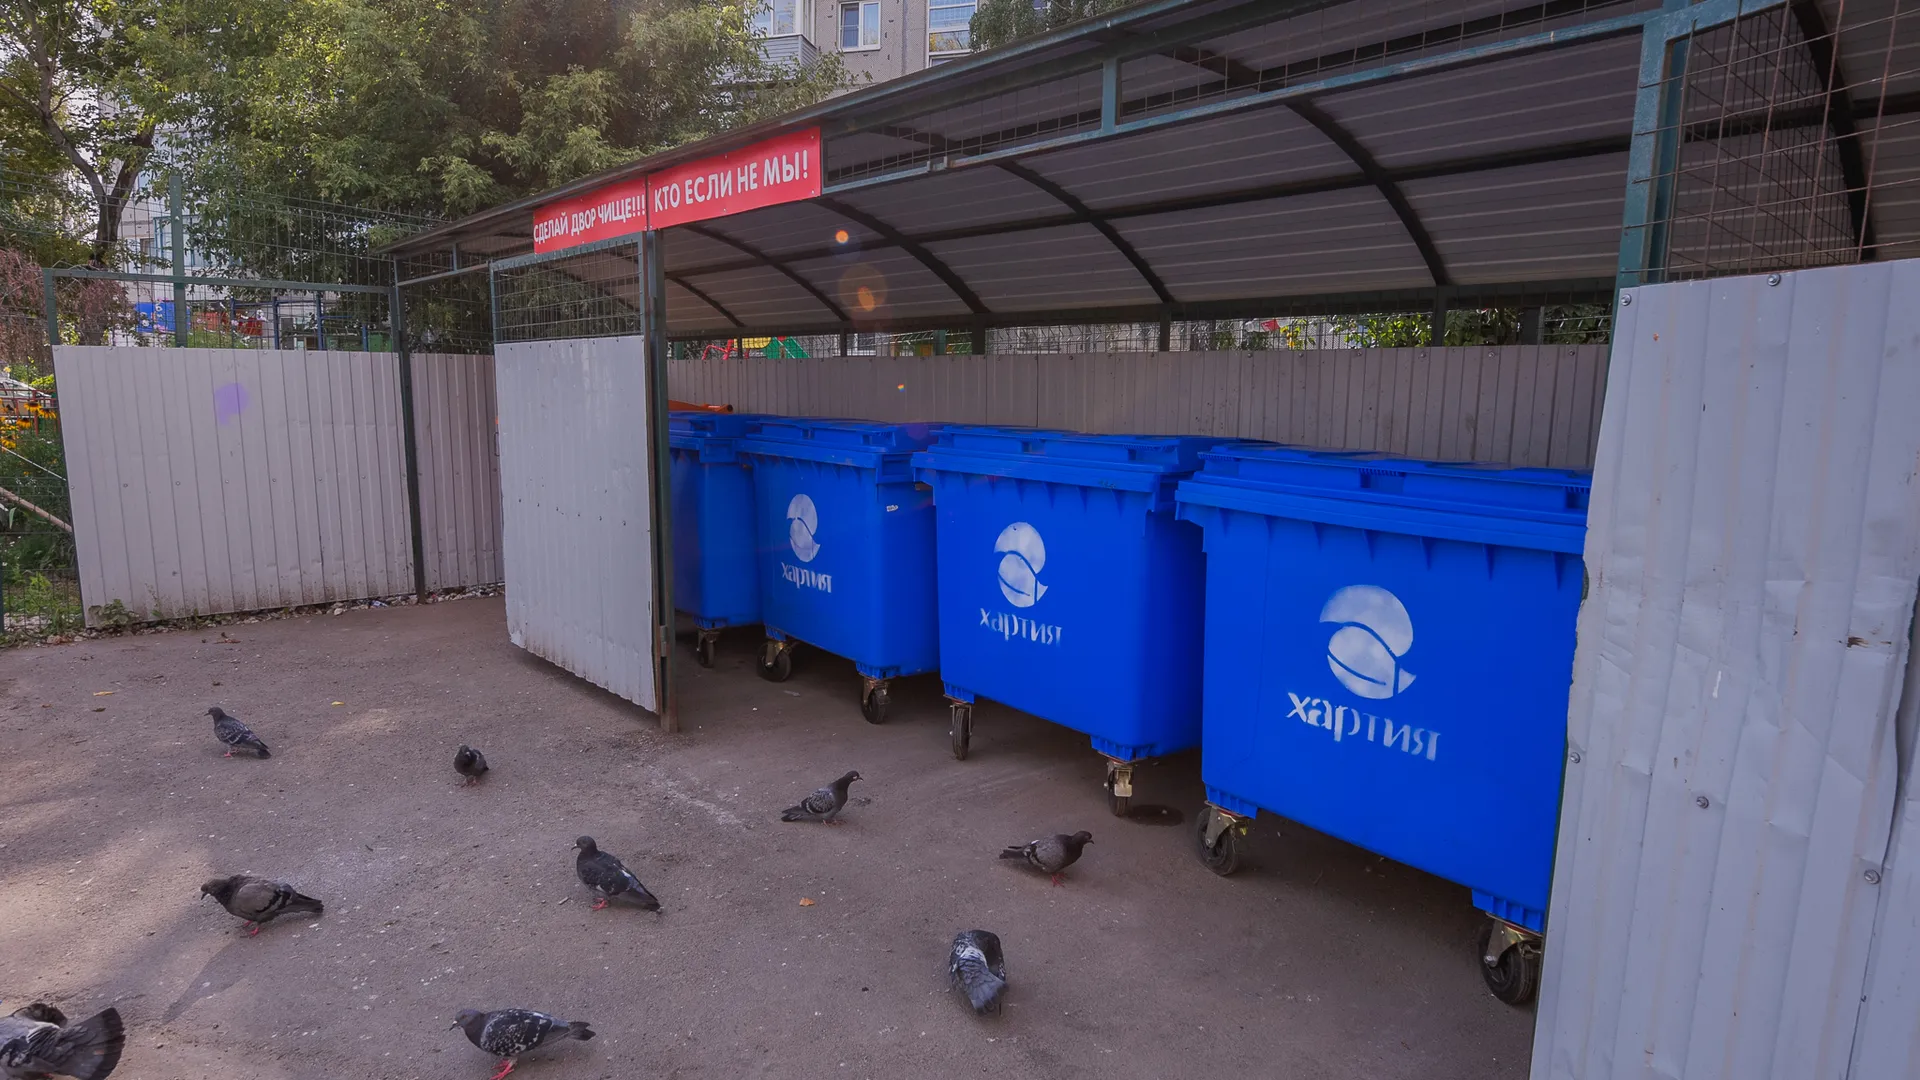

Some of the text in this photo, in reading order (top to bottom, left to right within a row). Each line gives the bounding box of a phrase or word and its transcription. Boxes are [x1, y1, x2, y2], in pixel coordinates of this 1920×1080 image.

[654, 149, 809, 213] КТО ЕСЛИ НЕ МЫ!
[534, 194, 645, 244] СДЕЛАЙ ДВОР ЧИЩЕ!!!
[781, 561, 832, 594] хартия
[979, 607, 1062, 647] хартия
[1285, 692, 1441, 762] хартия
